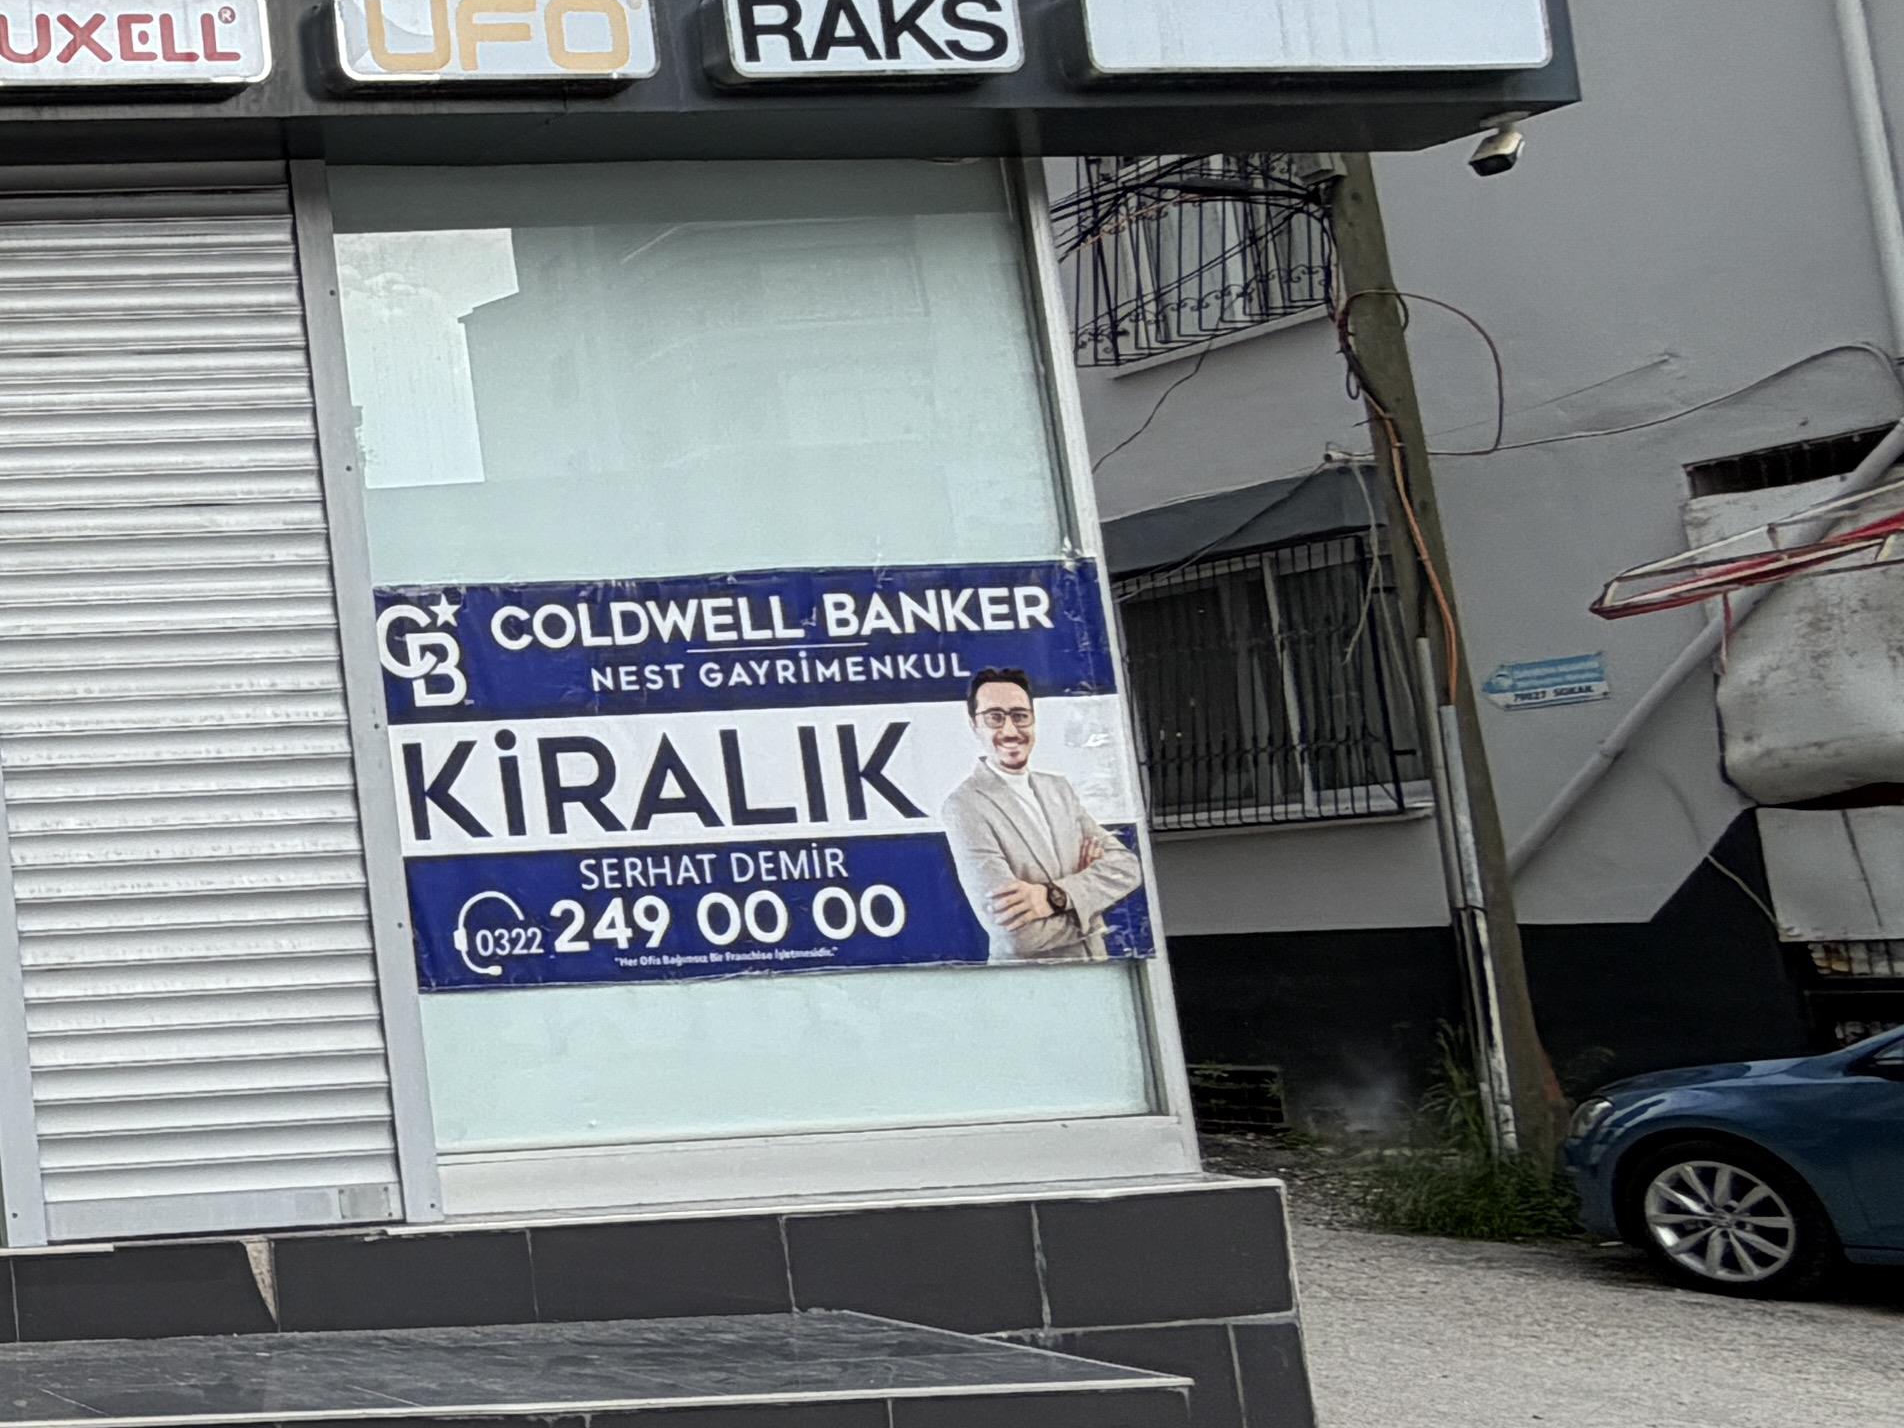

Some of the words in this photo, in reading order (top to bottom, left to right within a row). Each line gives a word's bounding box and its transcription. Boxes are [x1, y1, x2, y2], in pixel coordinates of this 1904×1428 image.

[490, 596, 806, 651] COLDWELL
[823, 585, 1055, 638] BANKER
[592, 664, 685, 694] NEST
[699, 650, 971, 689] GAYRİMENKUL
[580, 853, 718, 891] SERHAT
[730, 843, 849, 883] DEMİR
[476, 928, 545, 957] 0322
[550, 895, 672, 953] 249
[696, 889, 789, 946] 00
[812, 884, 906, 940] 00
